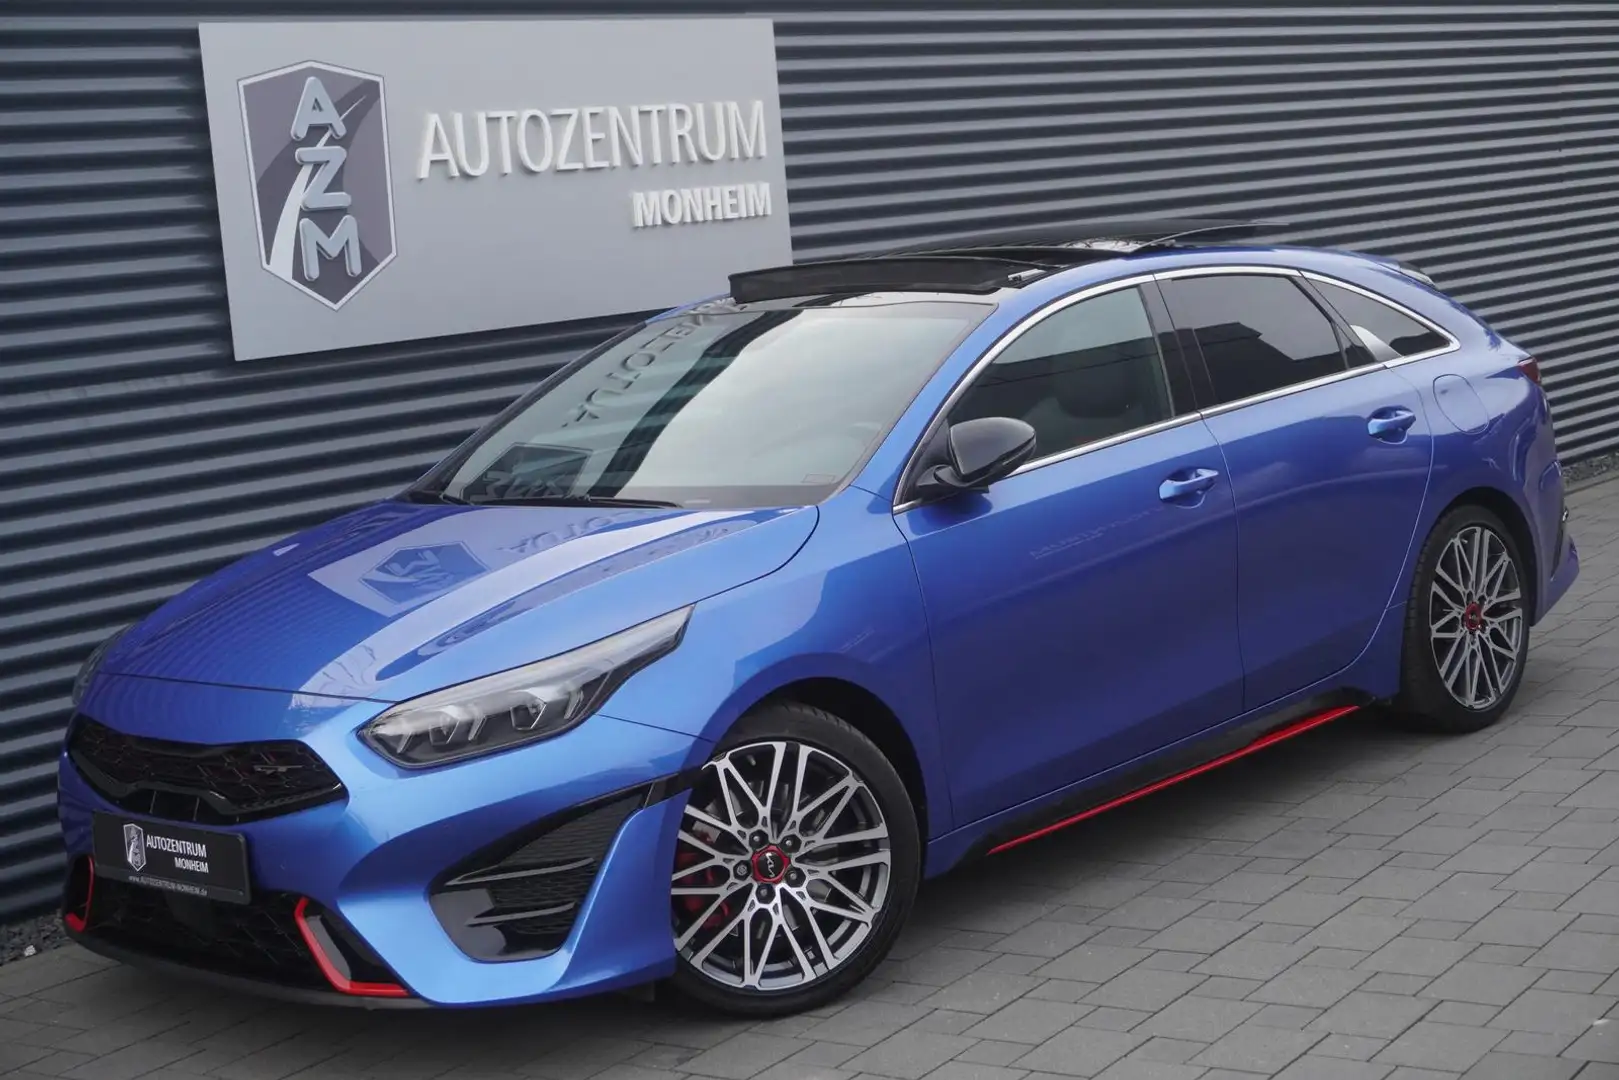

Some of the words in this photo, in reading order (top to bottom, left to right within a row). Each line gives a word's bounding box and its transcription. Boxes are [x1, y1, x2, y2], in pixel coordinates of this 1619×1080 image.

[416, 100, 768, 180] AUTOZENTRUM
[290, 76, 362, 281] AZM
[632, 181, 772, 229] MONHEIM
[146, 834, 207, 858] AUTOZENTRUM
[174, 857, 209, 874] MONHEIM
